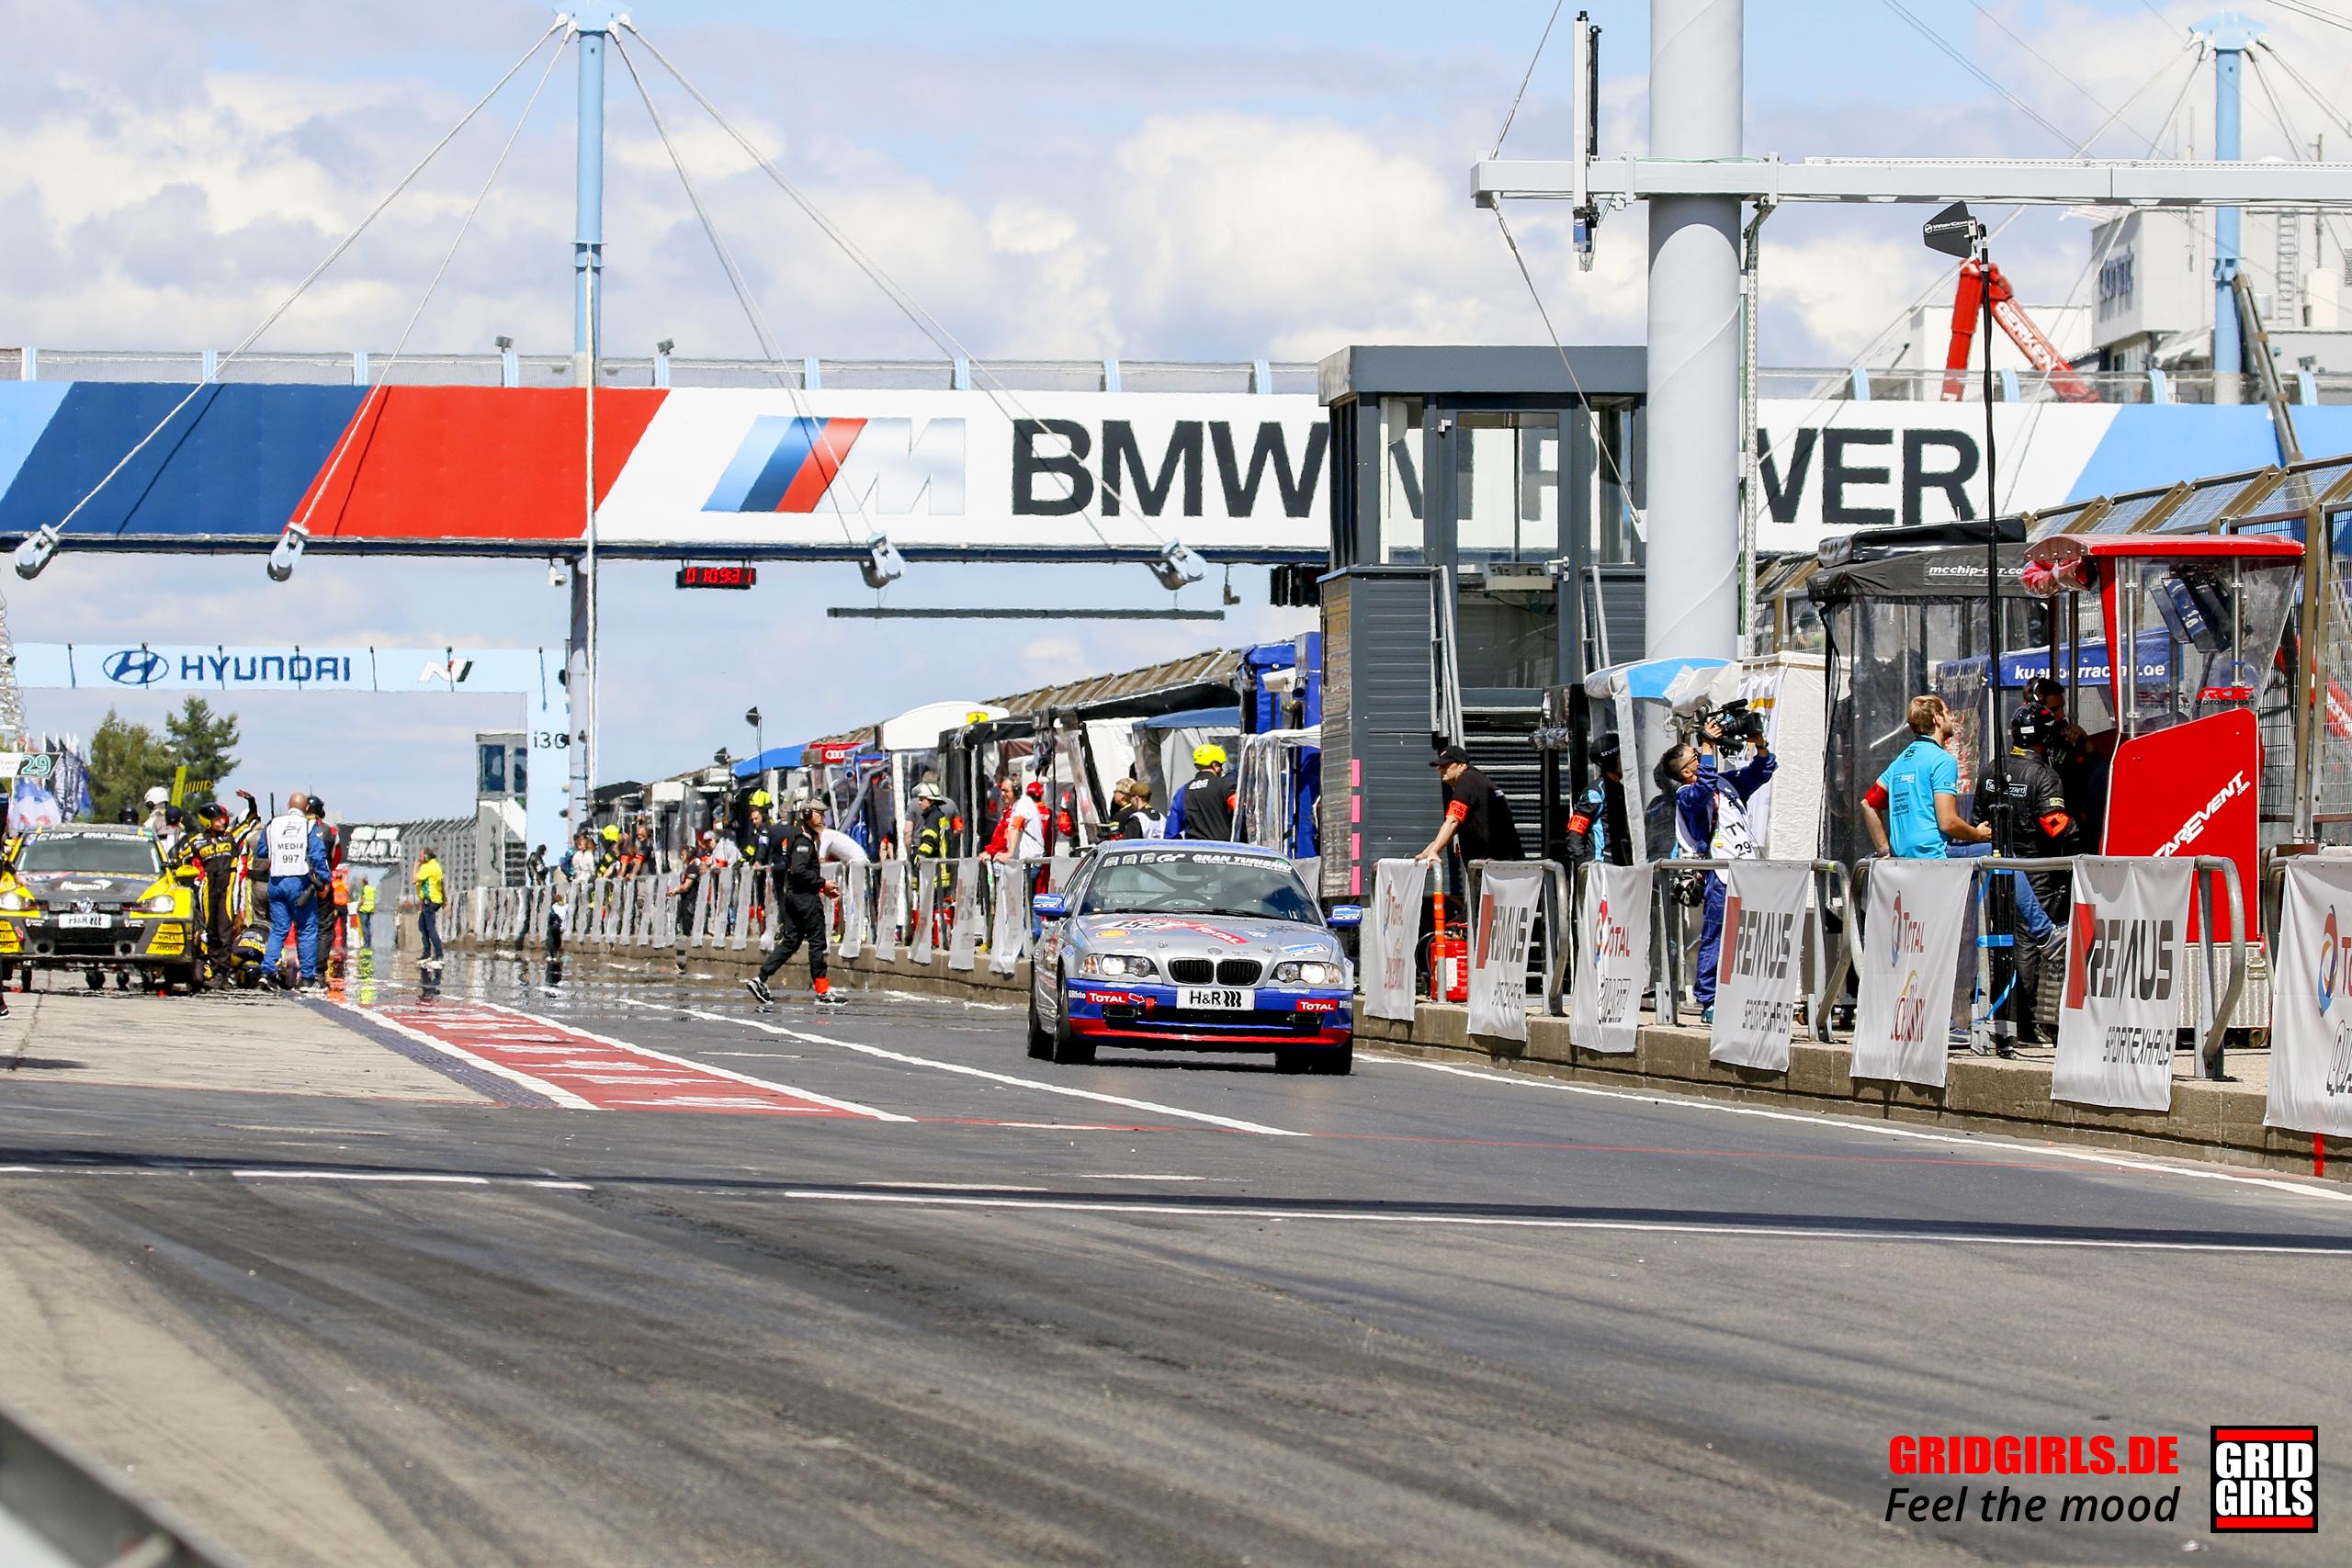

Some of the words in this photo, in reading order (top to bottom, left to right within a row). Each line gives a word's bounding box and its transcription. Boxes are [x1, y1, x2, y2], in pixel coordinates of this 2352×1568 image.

[1012, 418, 1329, 518] BMW
[181, 655, 350, 682] HYUNDAI
[20, 754, 51, 775] 29
[277, 842, 303, 851] MEDIA
[282, 855, 300, 863] 997
[1193, 853, 1230, 863] GRAN
[1731, 909, 1793, 983] REMUS
[2085, 919, 2174, 1009] REMUS
[1089, 992, 1126, 1003] TOTAL
[1190, 990, 1221, 1006] H&R
[1300, 1001, 1334, 1010] TOTAL
